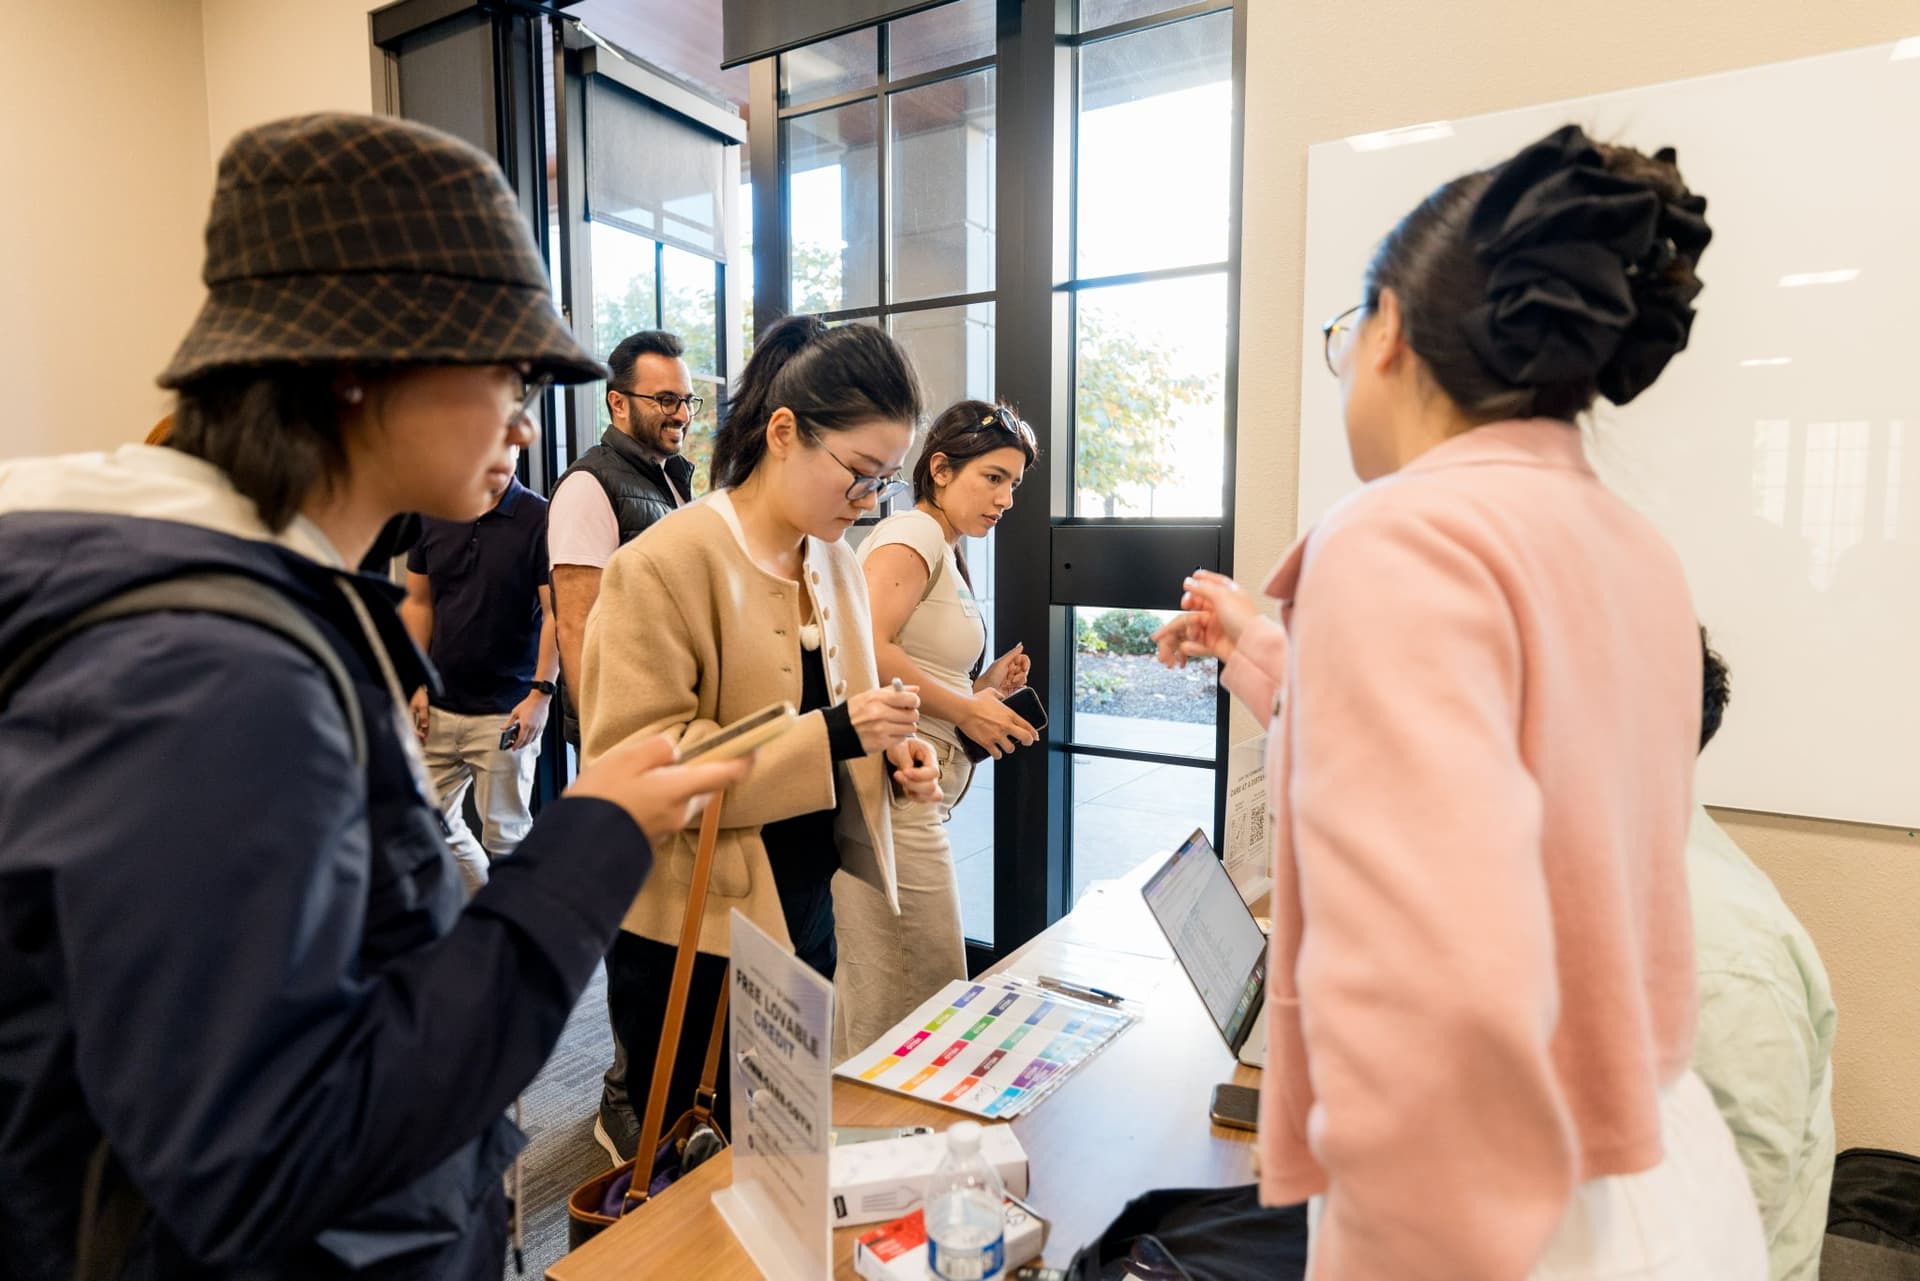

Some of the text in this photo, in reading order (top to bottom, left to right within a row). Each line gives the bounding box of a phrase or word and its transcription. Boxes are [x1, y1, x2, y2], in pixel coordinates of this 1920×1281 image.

[736, 969, 761, 1006] FREE
[764, 994, 819, 1060] LOVABLE
[753, 1009, 795, 1060] CREDIT
